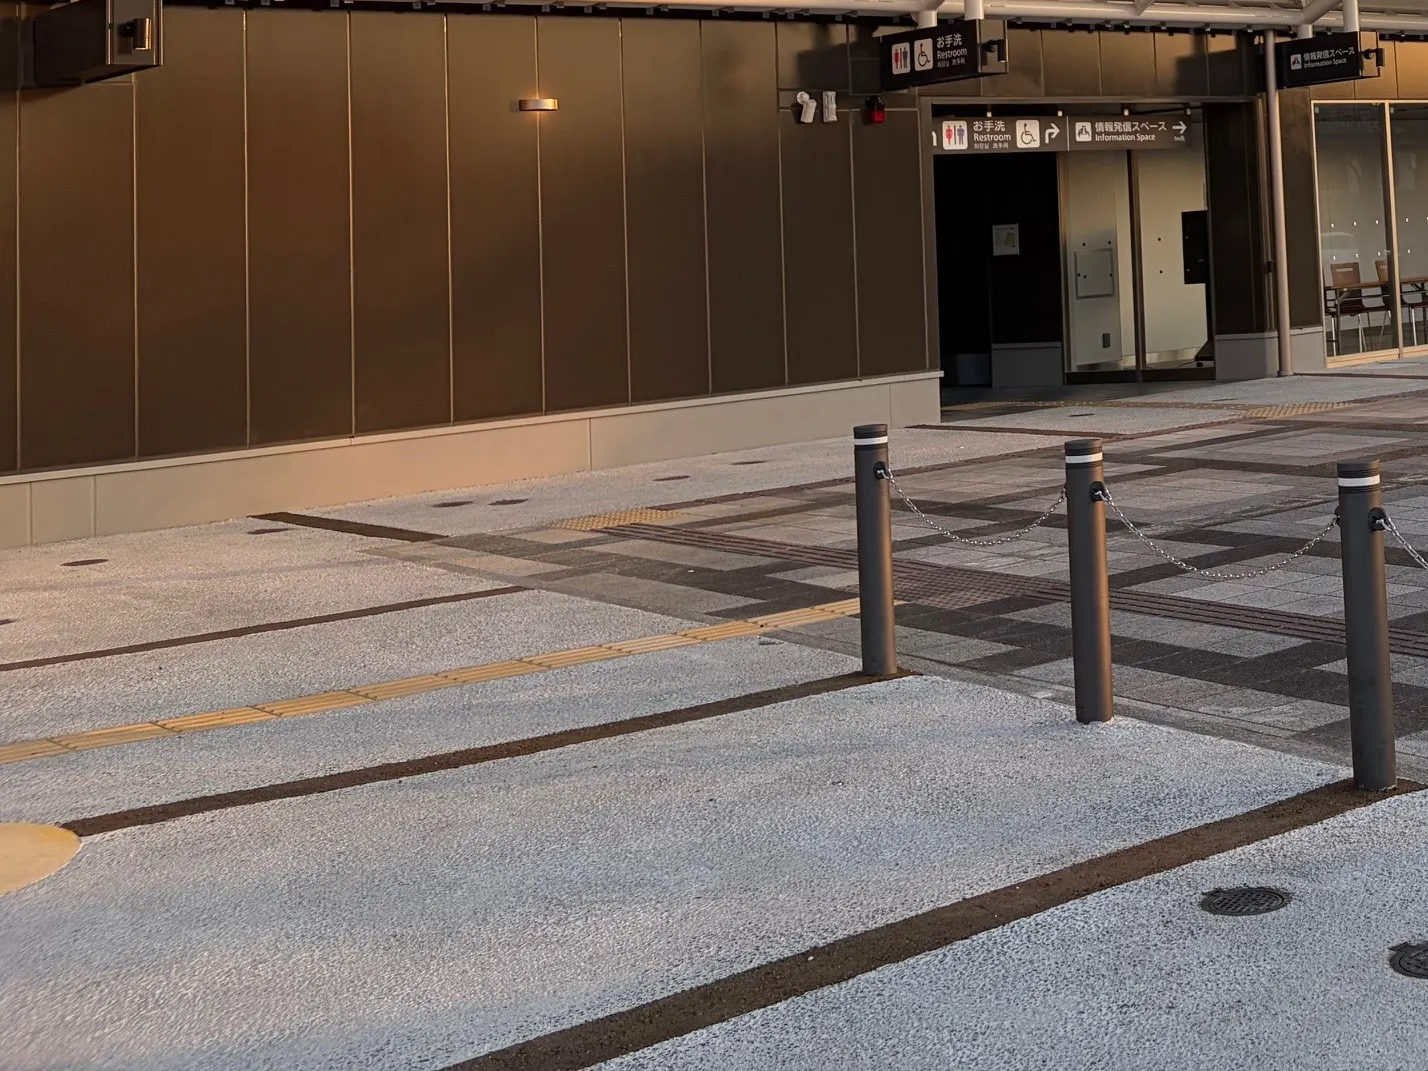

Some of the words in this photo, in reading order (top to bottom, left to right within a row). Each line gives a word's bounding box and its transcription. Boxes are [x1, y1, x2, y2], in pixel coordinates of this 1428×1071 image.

[936, 48, 968, 60] Restroom
[1304, 59, 1332, 68] Information
[972, 120, 1006, 132] お手洗
[1094, 121, 1167, 133] 情報発信スペース
[973, 132, 1012, 142] Restroom
[1095, 132, 1136, 142] Information
[1136, 132, 1156, 143] Space
